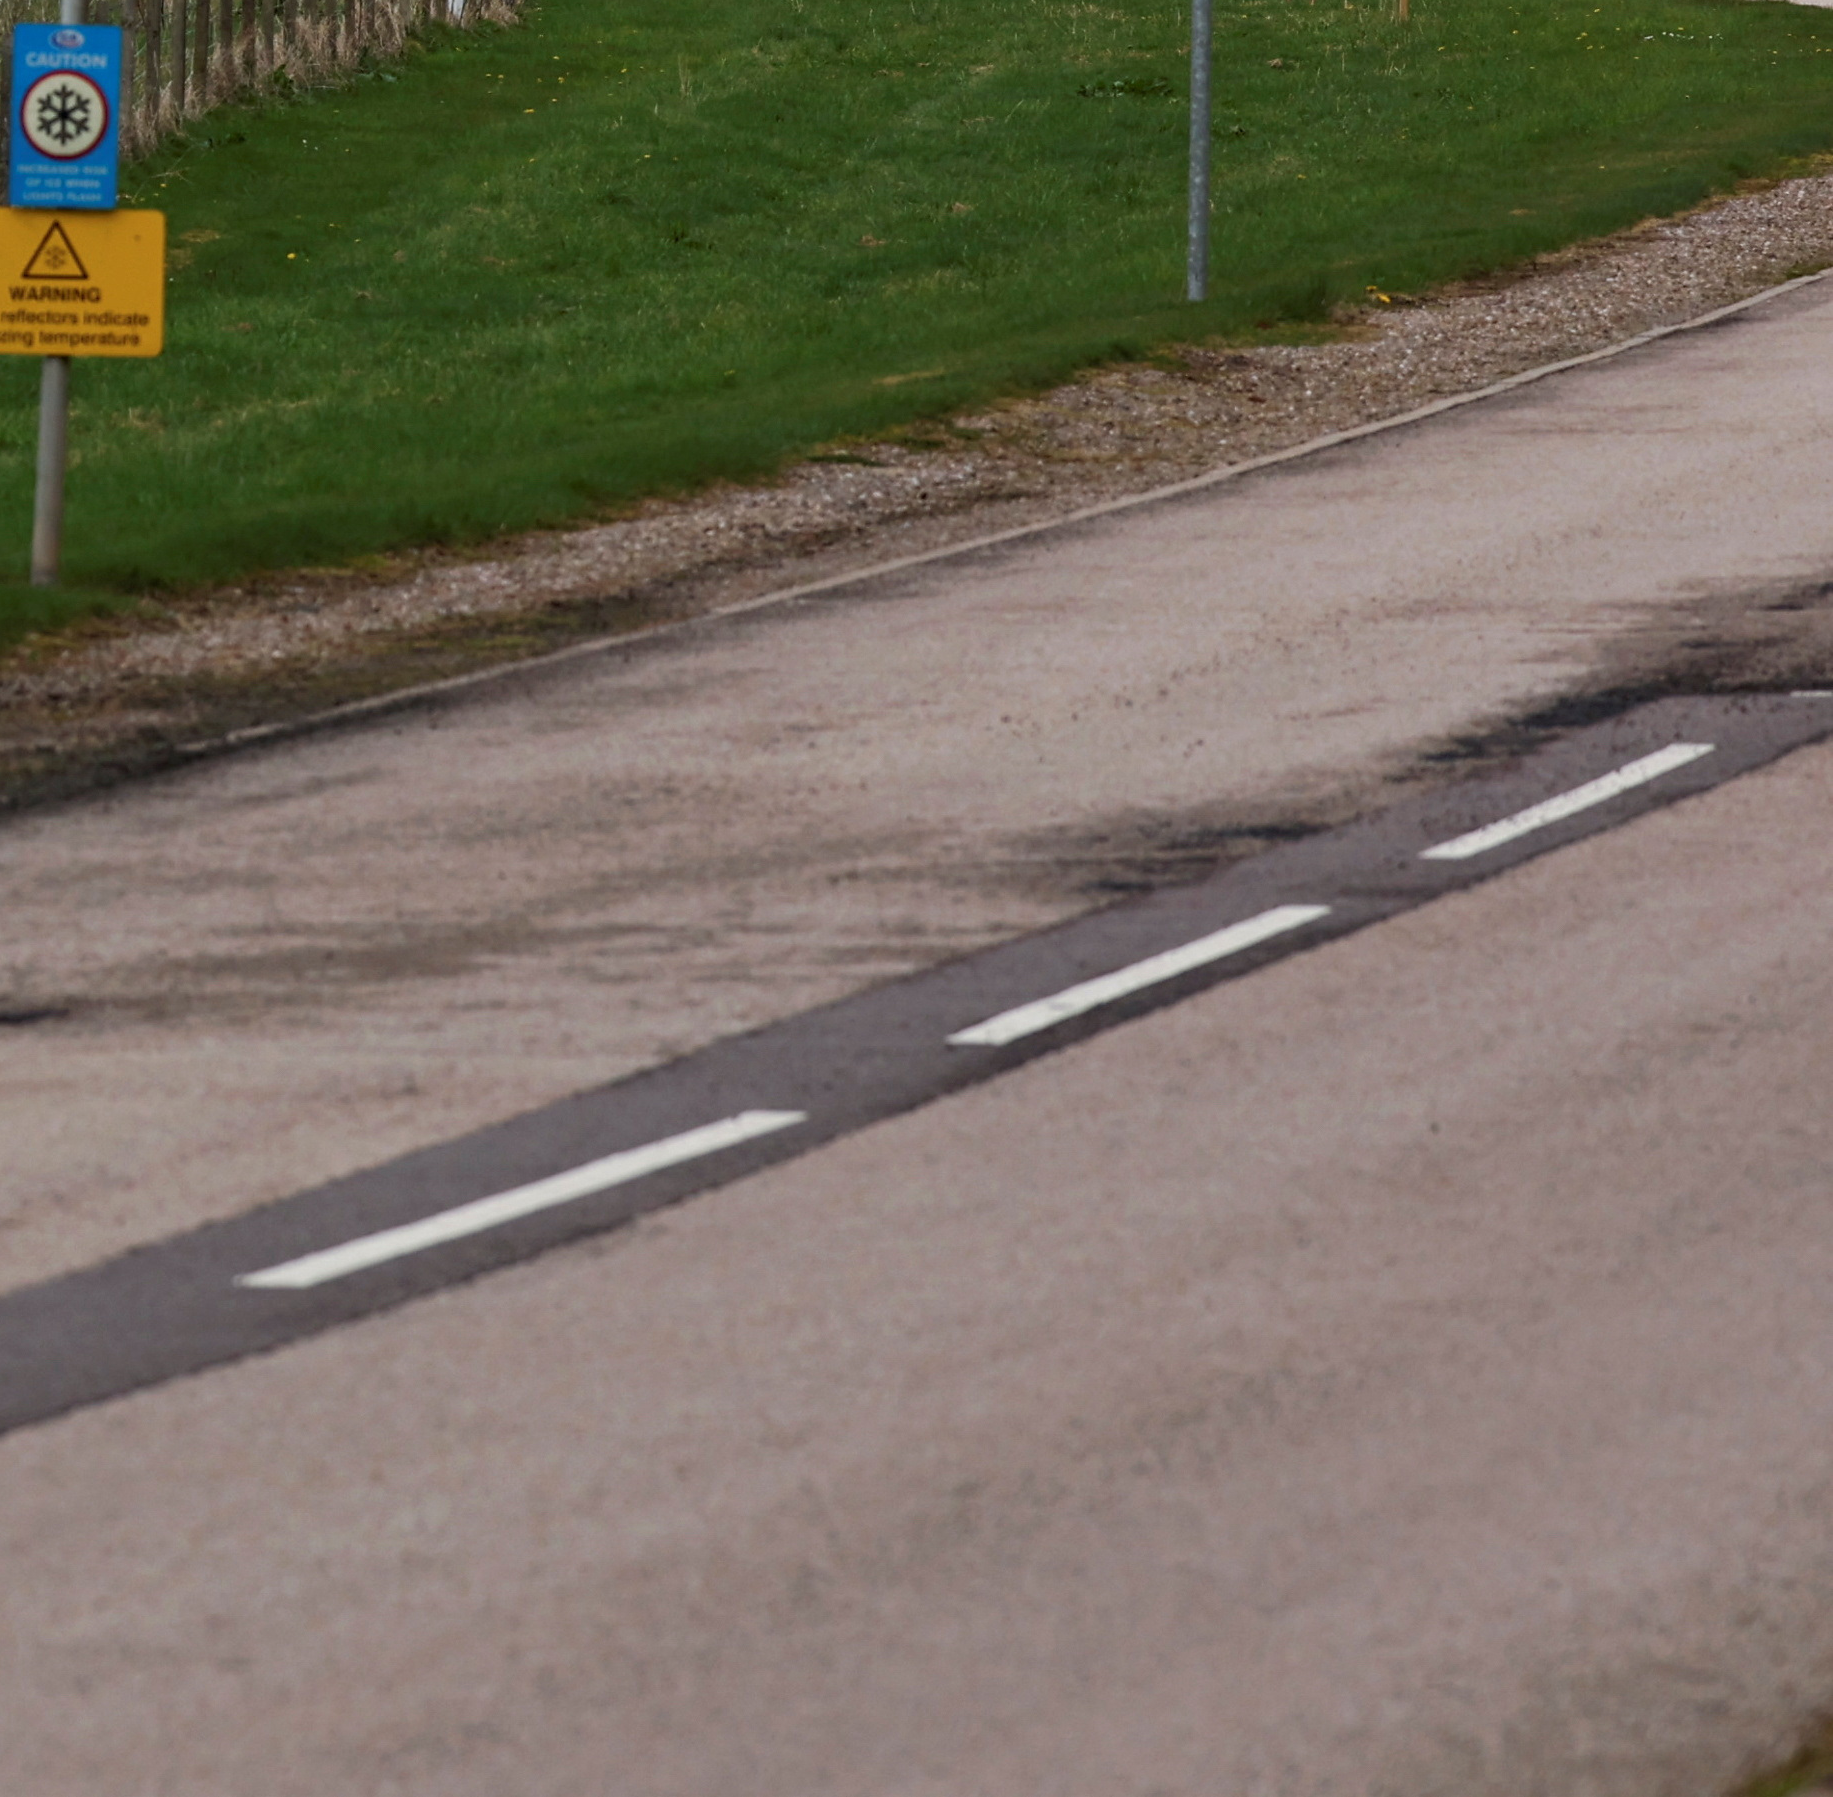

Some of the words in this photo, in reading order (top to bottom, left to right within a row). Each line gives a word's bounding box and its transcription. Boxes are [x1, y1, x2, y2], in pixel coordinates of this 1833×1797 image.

[25, 51, 109, 70] CAUTION
[9, 285, 101, 303] WARNING
[0, 308, 79, 325] reflectors
[83, 310, 150, 326] indicate
[38, 329, 141, 347] temperature
